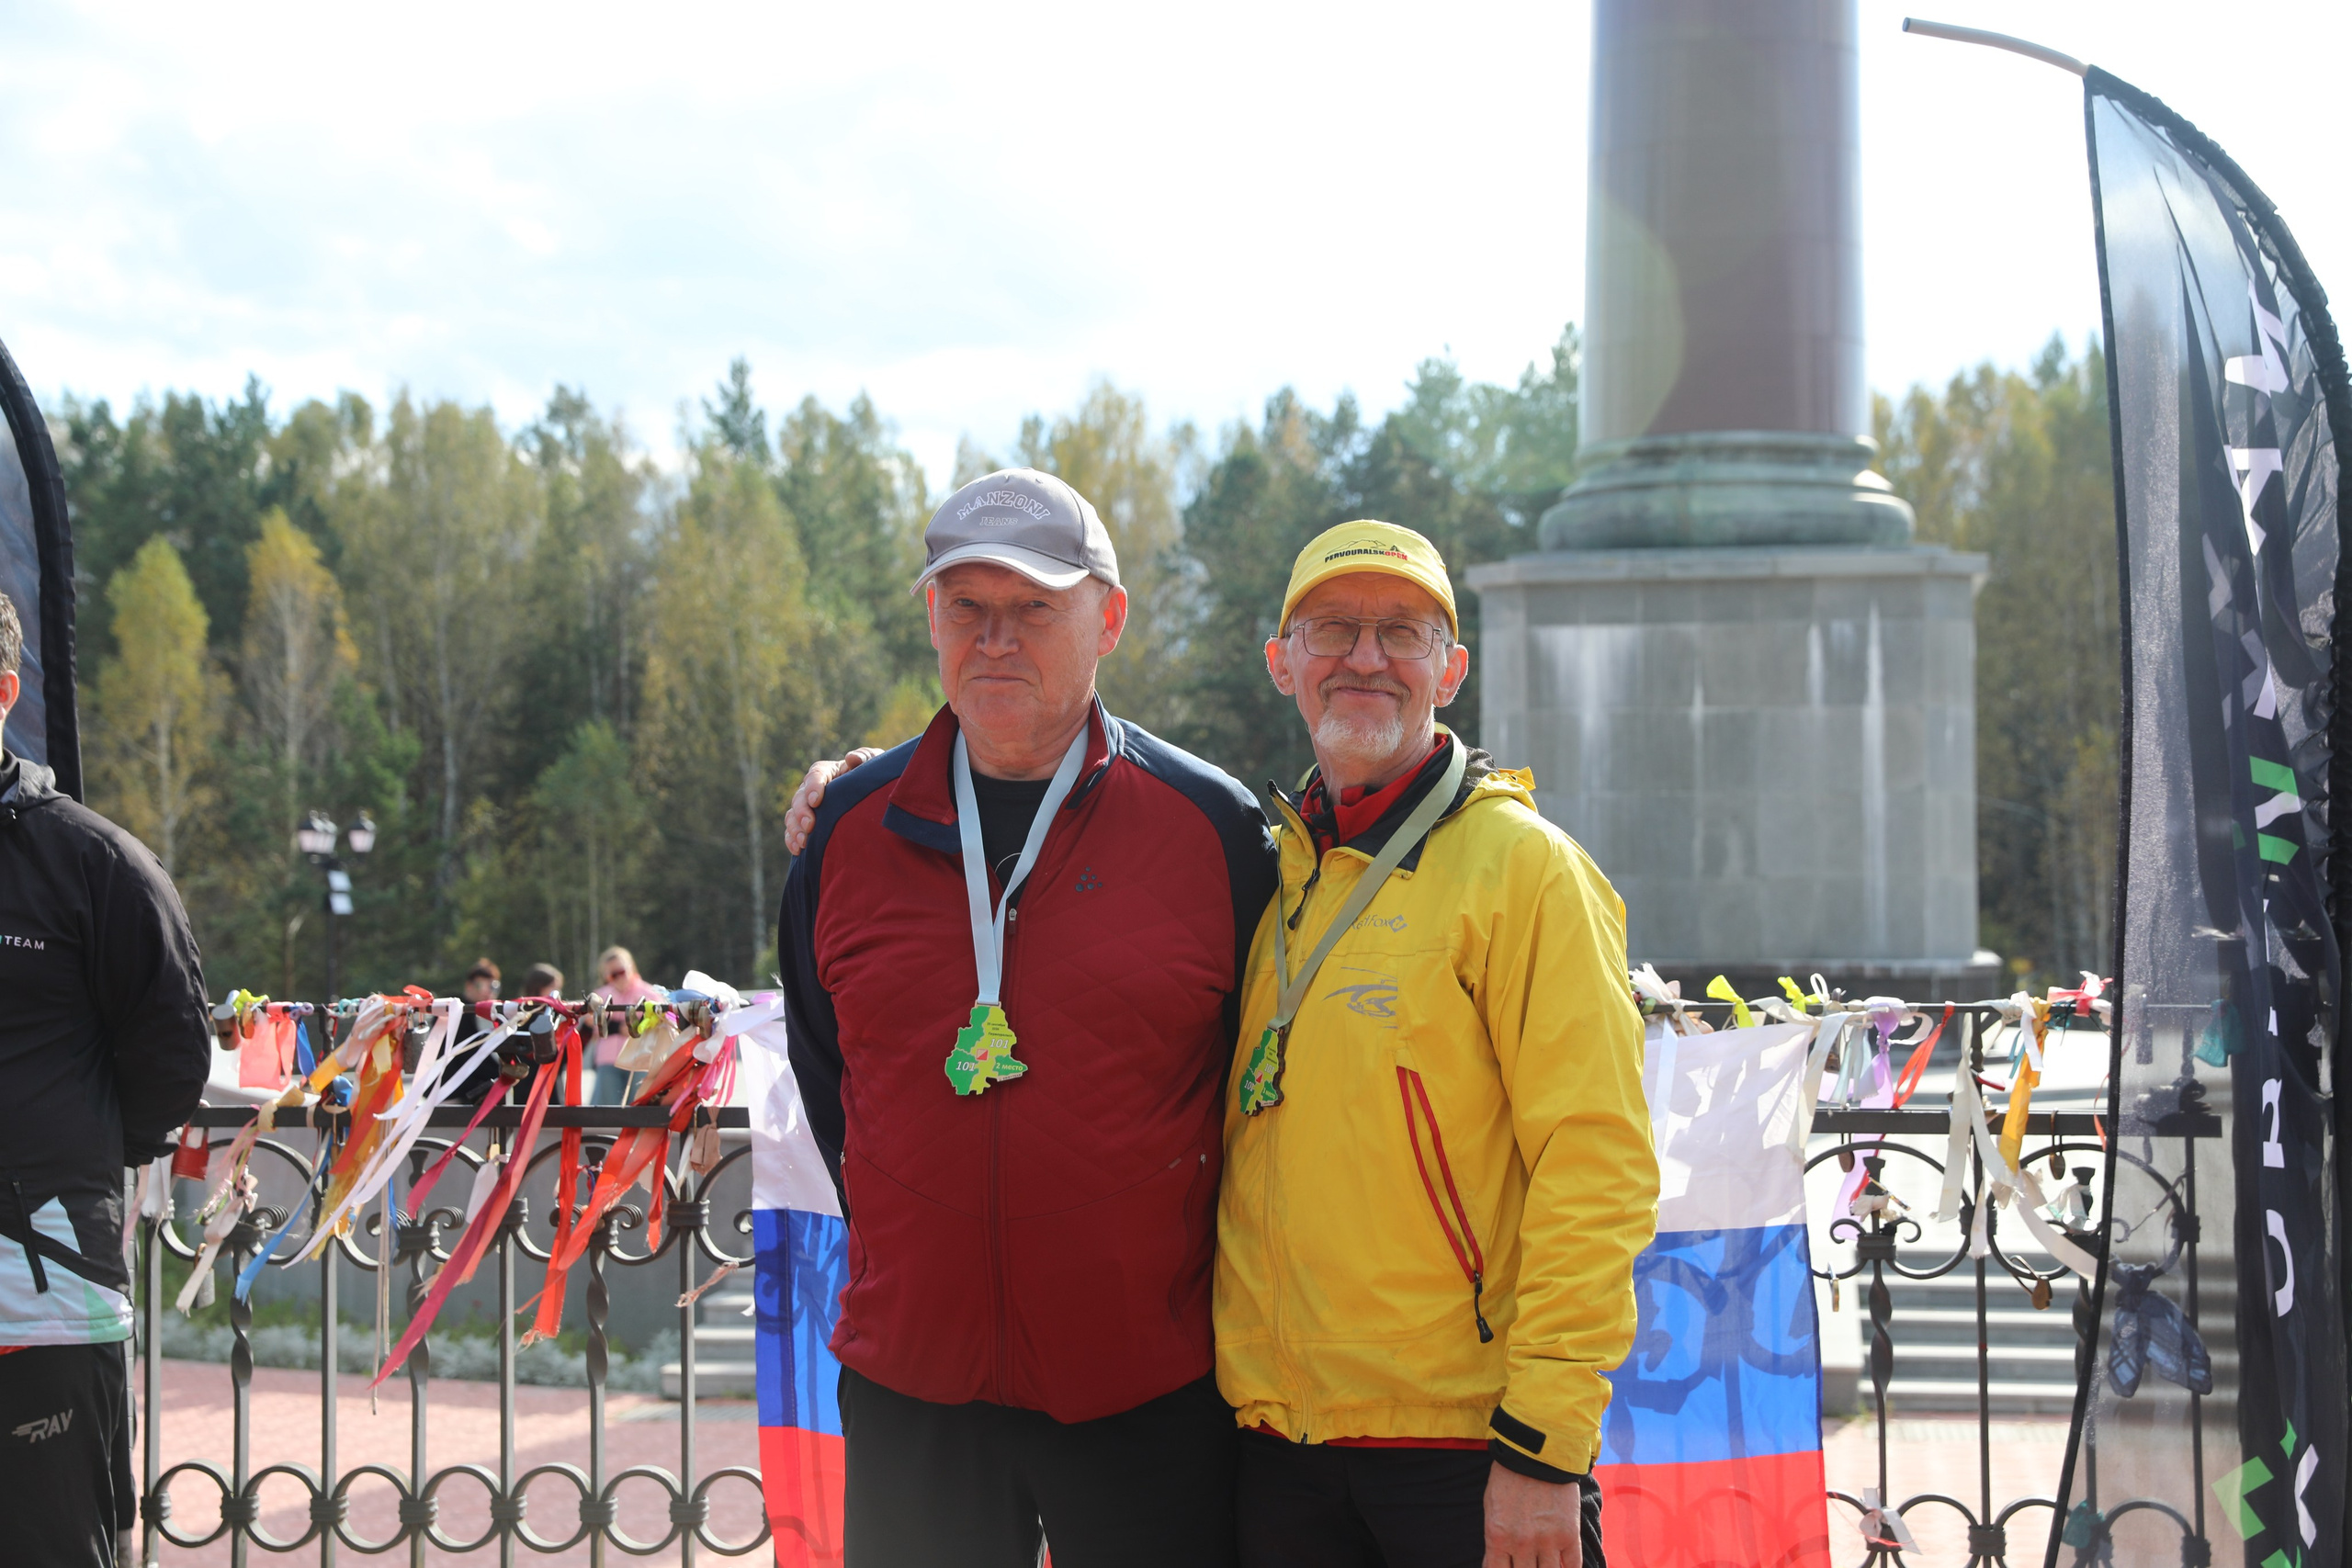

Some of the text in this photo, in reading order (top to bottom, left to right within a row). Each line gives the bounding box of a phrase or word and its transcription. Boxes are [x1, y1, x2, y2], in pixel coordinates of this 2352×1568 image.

[956, 490, 1051, 521] MANZONI
[979, 516, 1019, 526] JEANS
[0, 934, 45, 951] TEAM
[989, 1038, 1010, 1049] 101
[956, 1061, 976, 1072] 101
[1264, 1063, 1275, 1075] 101
